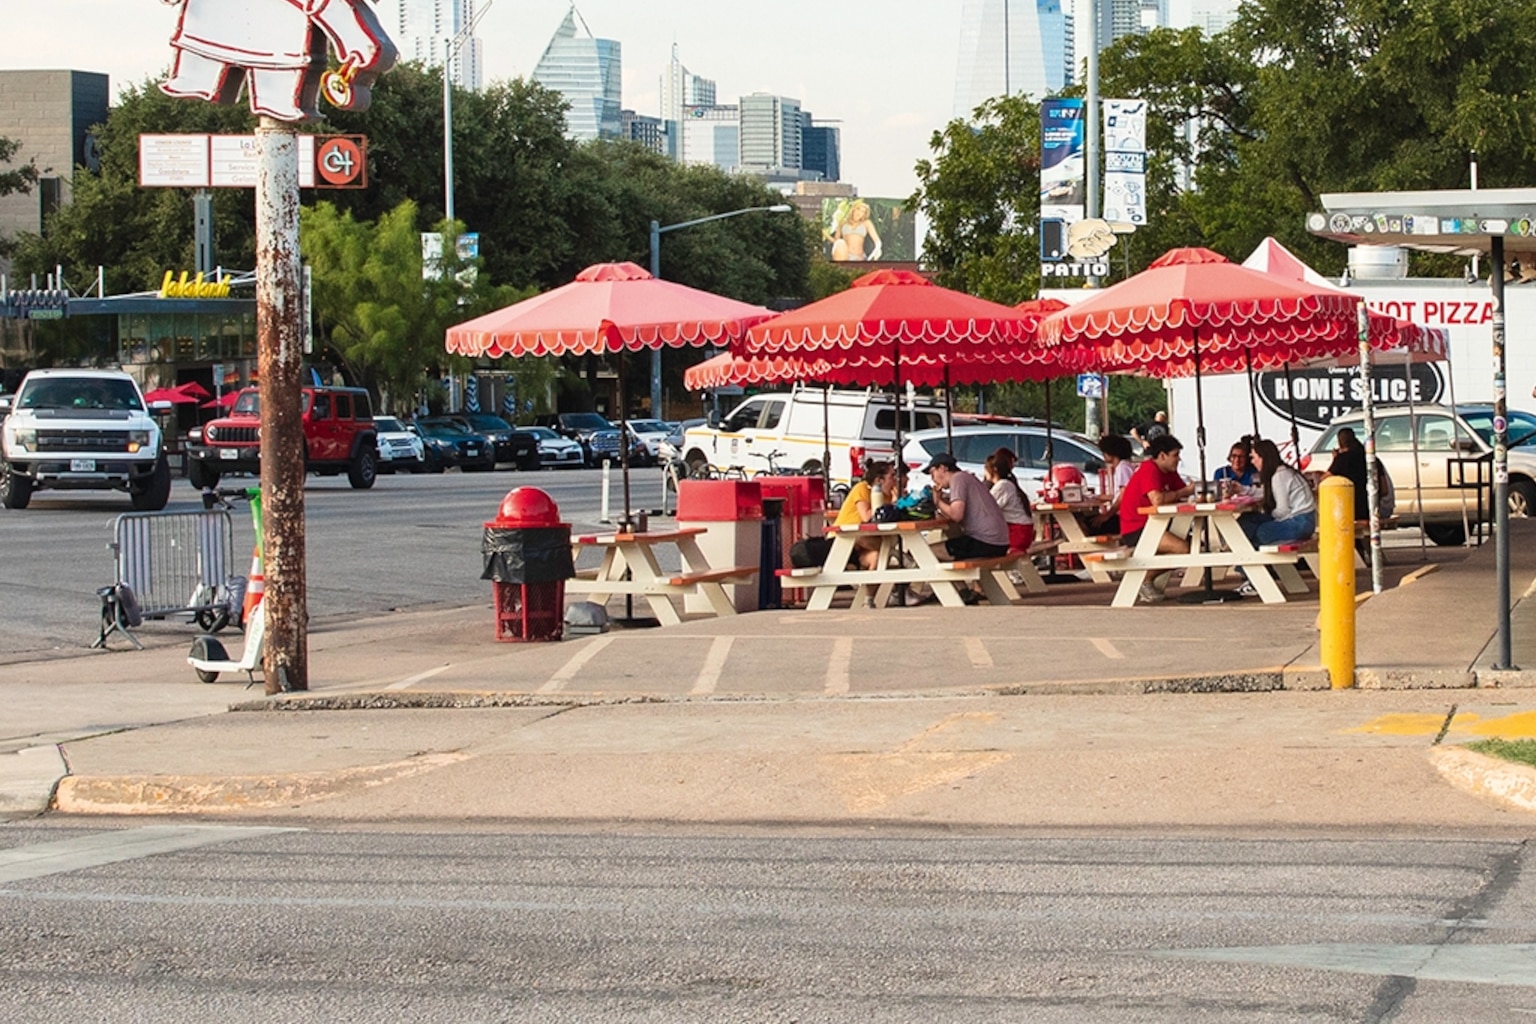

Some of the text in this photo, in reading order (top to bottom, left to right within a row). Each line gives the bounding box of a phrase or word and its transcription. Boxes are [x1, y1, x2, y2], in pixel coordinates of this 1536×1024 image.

[1041, 262, 1107, 277] PATIO
[1274, 377, 1422, 402] HOME SLICE
